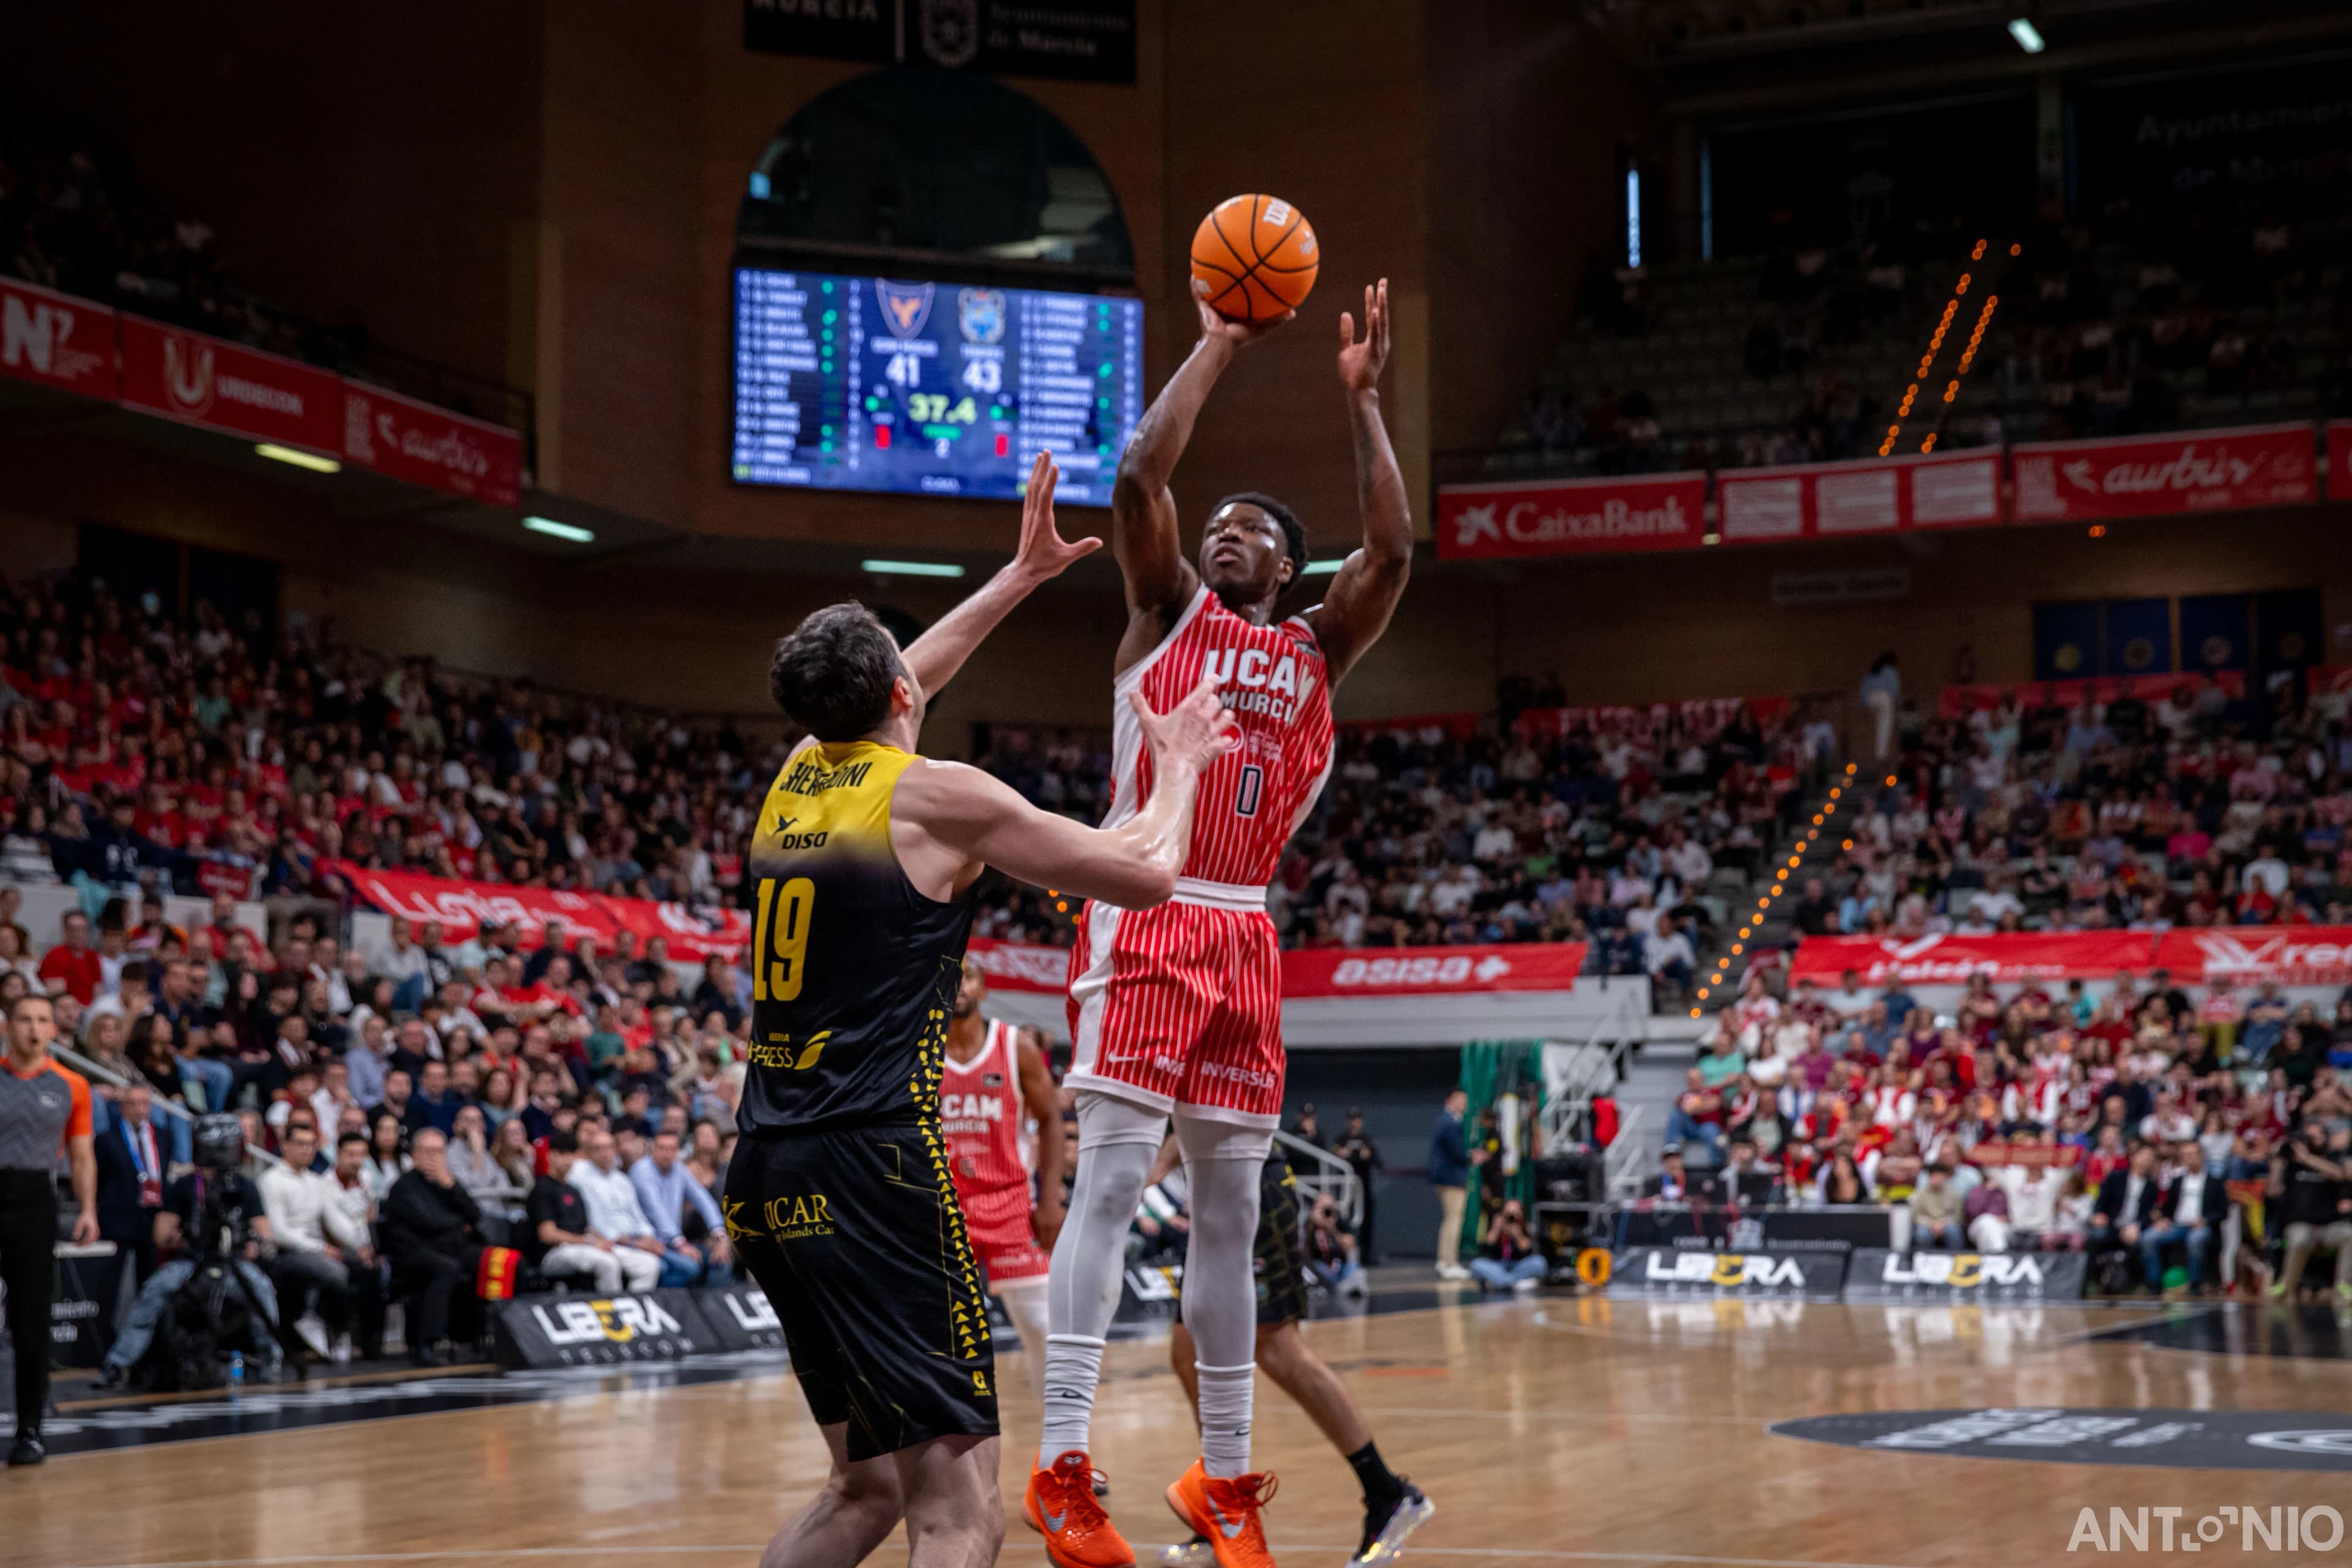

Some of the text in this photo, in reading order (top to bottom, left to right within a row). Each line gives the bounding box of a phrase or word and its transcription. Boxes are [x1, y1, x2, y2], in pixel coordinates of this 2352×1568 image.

[886, 353, 921, 388] 41
[908, 392, 977, 425] 37.4
[1506, 495, 1690, 543] CaixaBank
[1219, 690, 1297, 725] MURCI
[1235, 764, 1264, 818] 0
[753, 876, 816, 1001] 19
[1332, 956, 1472, 987] asisa
[941, 1092, 1003, 1122] CAM
[1645, 1250, 1807, 1286] LIBERA
[1882, 1251, 2045, 1287] LIBERA
[531, 1295, 682, 1344] LIBERA
